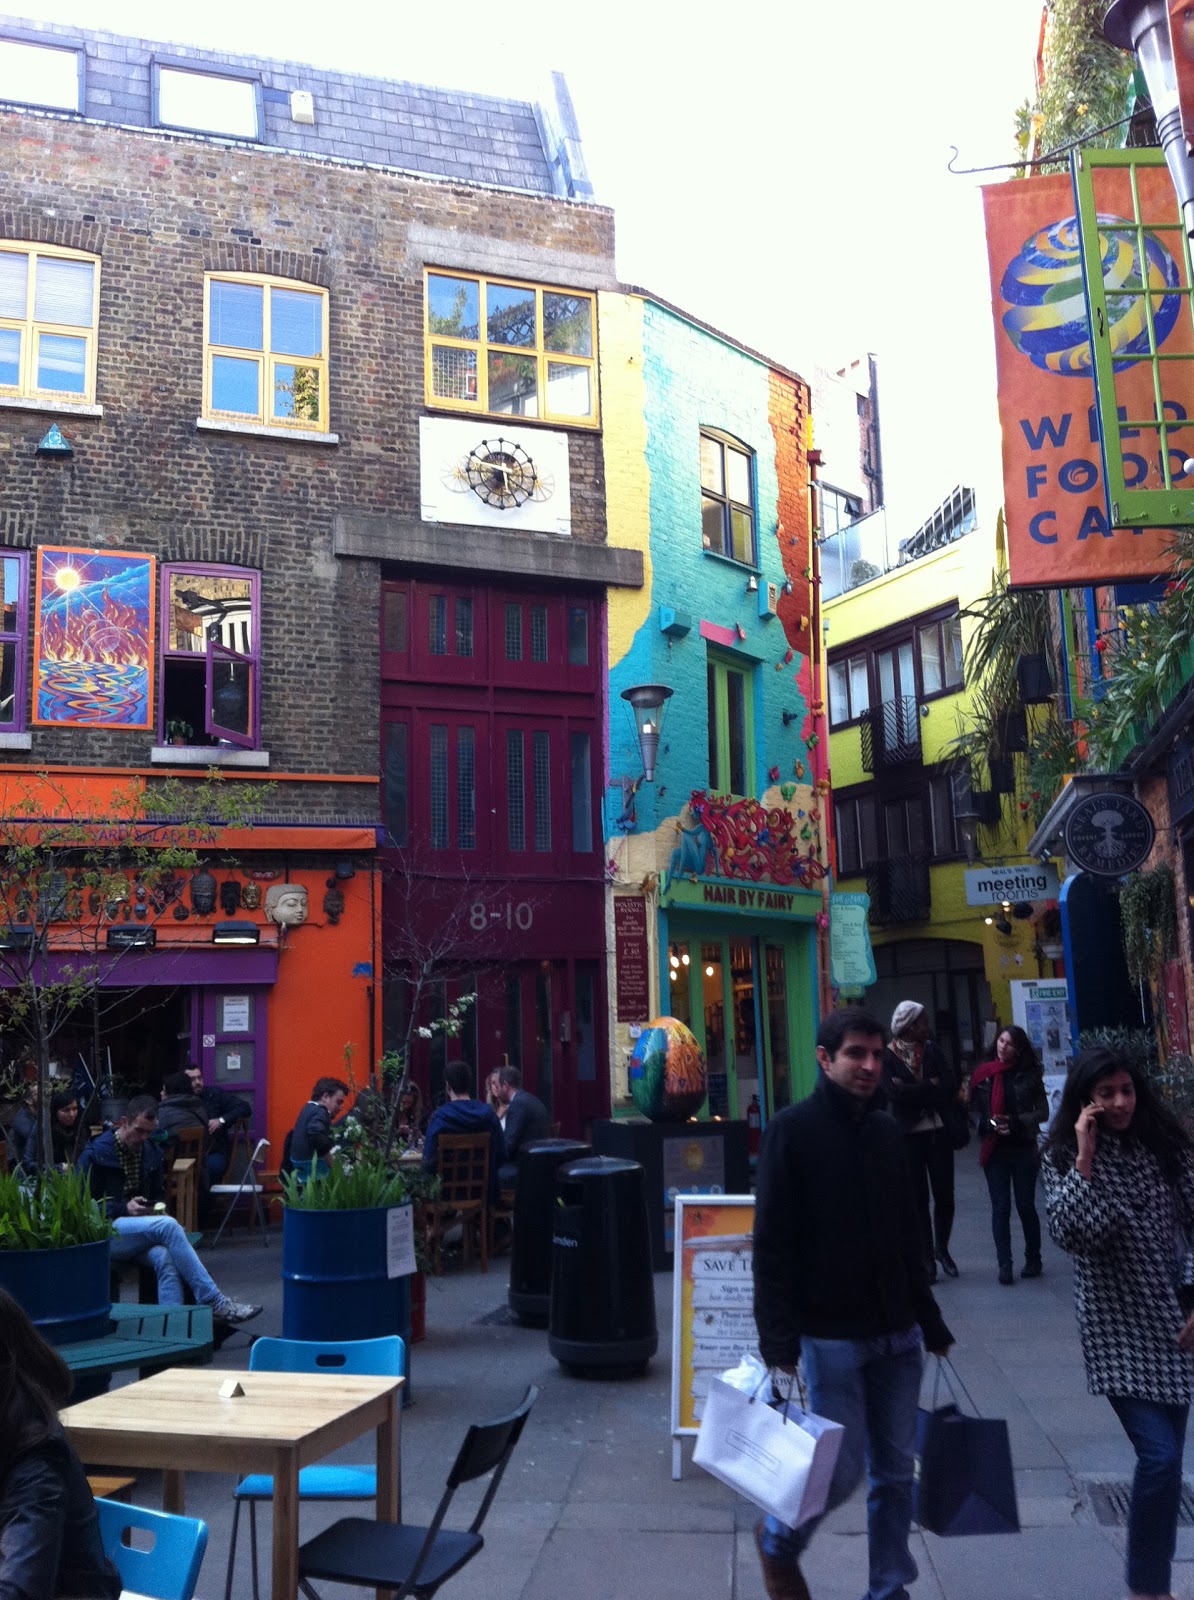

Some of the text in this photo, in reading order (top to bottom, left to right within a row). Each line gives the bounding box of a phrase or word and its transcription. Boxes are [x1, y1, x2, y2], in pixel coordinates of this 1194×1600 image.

[1019, 400, 1187, 451] WILD
[1026, 449, 1191, 499] FOOD
[978, 875, 1048, 892] meeting
[992, 888, 1039, 901] rooms
[704, 884, 794, 910] HAIR BY FAIRY
[470, 902, 533, 930] 8-10
[704, 1259, 735, 1271] SAVE
